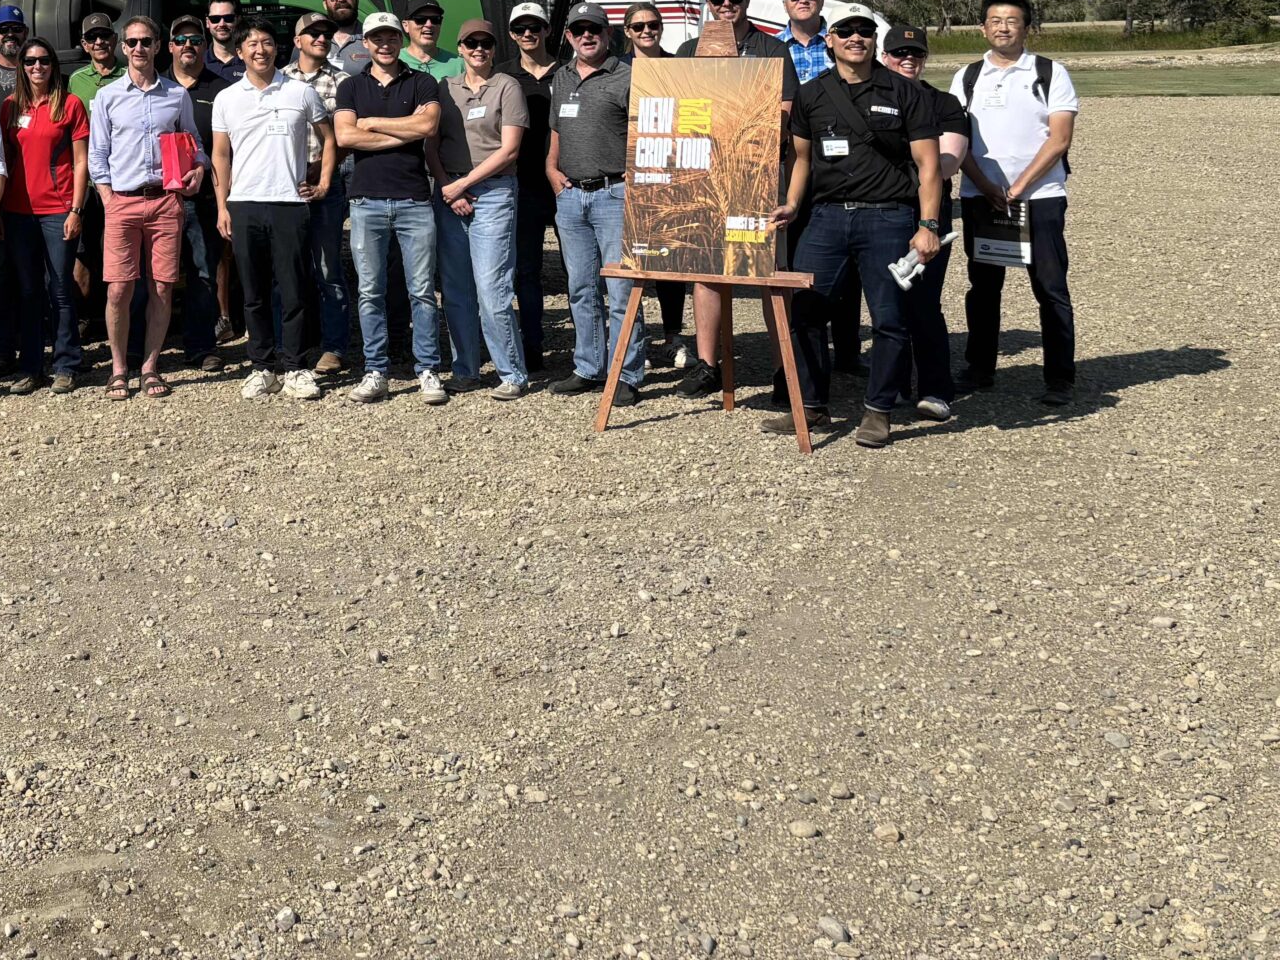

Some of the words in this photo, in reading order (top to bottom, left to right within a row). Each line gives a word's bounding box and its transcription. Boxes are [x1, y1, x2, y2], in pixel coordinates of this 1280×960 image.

[637, 97, 675, 134] NEW
[677, 98, 712, 134] 2024
[635, 137, 673, 169] CROP
[675, 138, 712, 171] TOUR
